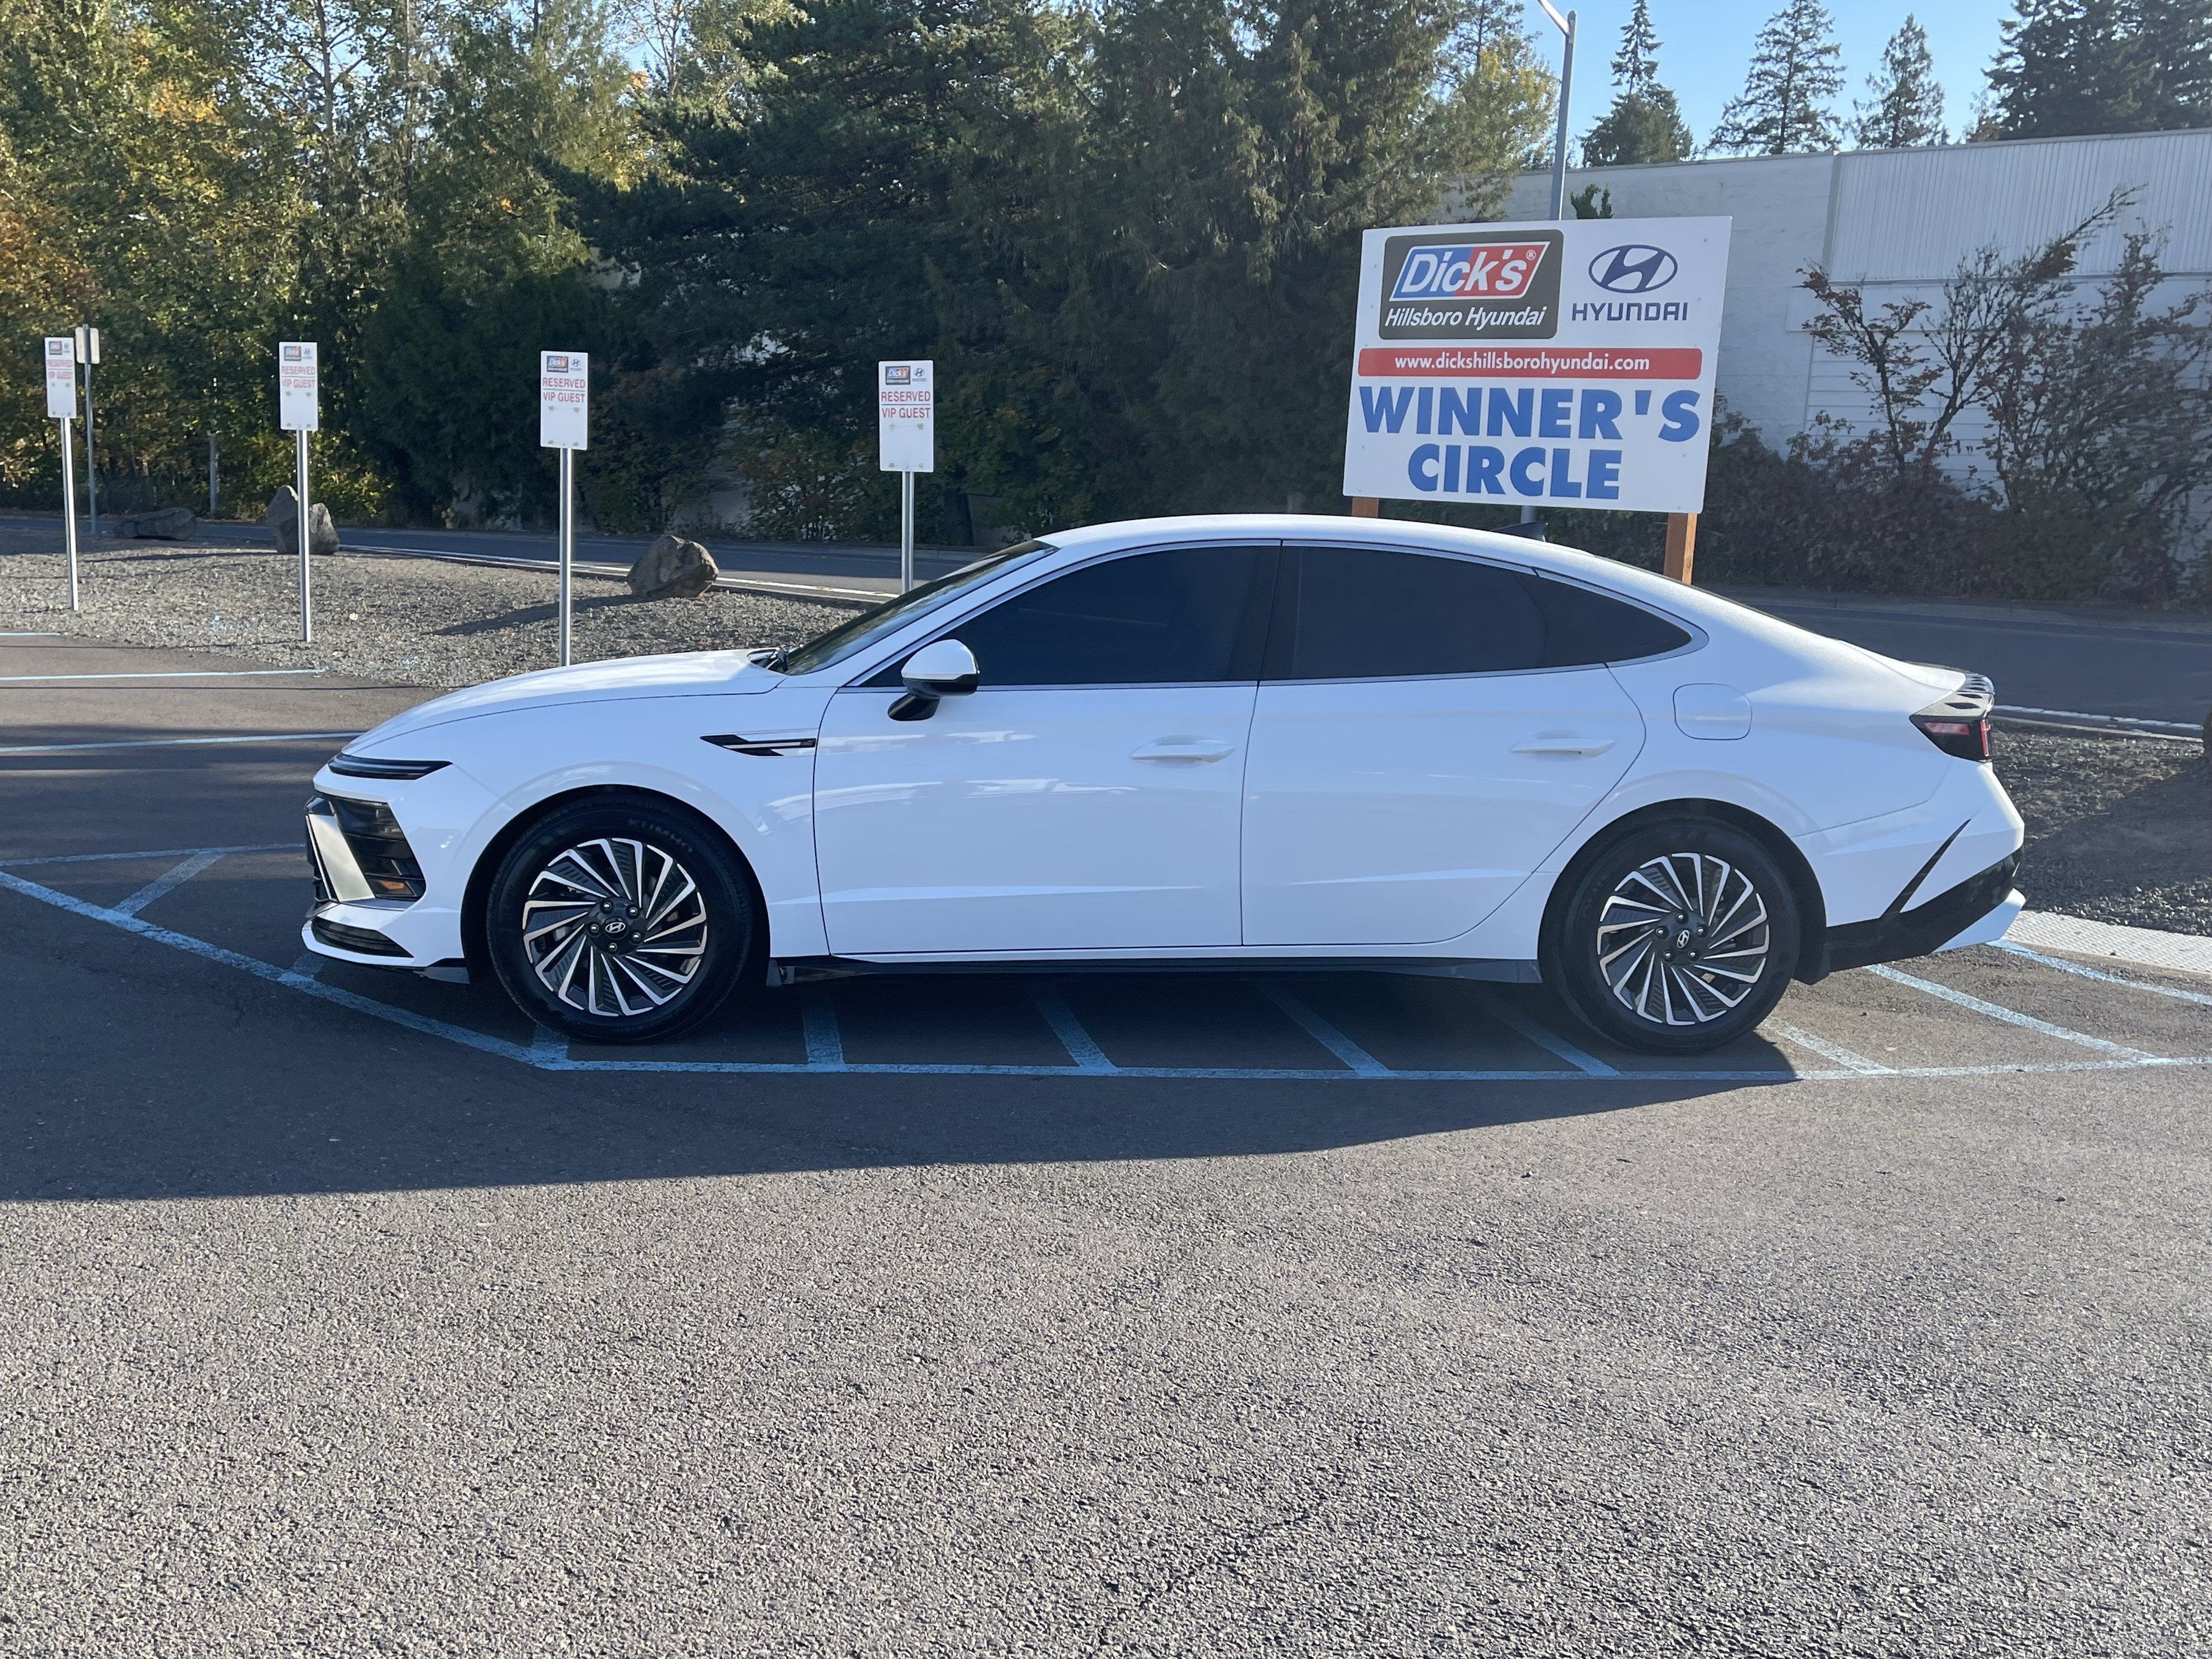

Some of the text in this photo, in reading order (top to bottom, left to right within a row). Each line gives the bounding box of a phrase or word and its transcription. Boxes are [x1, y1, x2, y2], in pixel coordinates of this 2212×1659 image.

[1572, 302, 1689, 321] HYUNDAI
[1385, 306, 1547, 331] Hillsboro Hyundai
[1395, 351, 1650, 374] www.dickshillsborohyundai.com
[281, 366, 315, 375] RESERVED
[294, 379, 315, 388] GUEST
[542, 377, 585, 388] RESERVED
[543, 392, 585, 403] VIP GUEST
[881, 391, 930, 402] RESERVED
[882, 408, 930, 418] VIP GUEST
[1359, 386, 1701, 442] WINNER'S
[1408, 443, 1622, 500] CIRCLE
